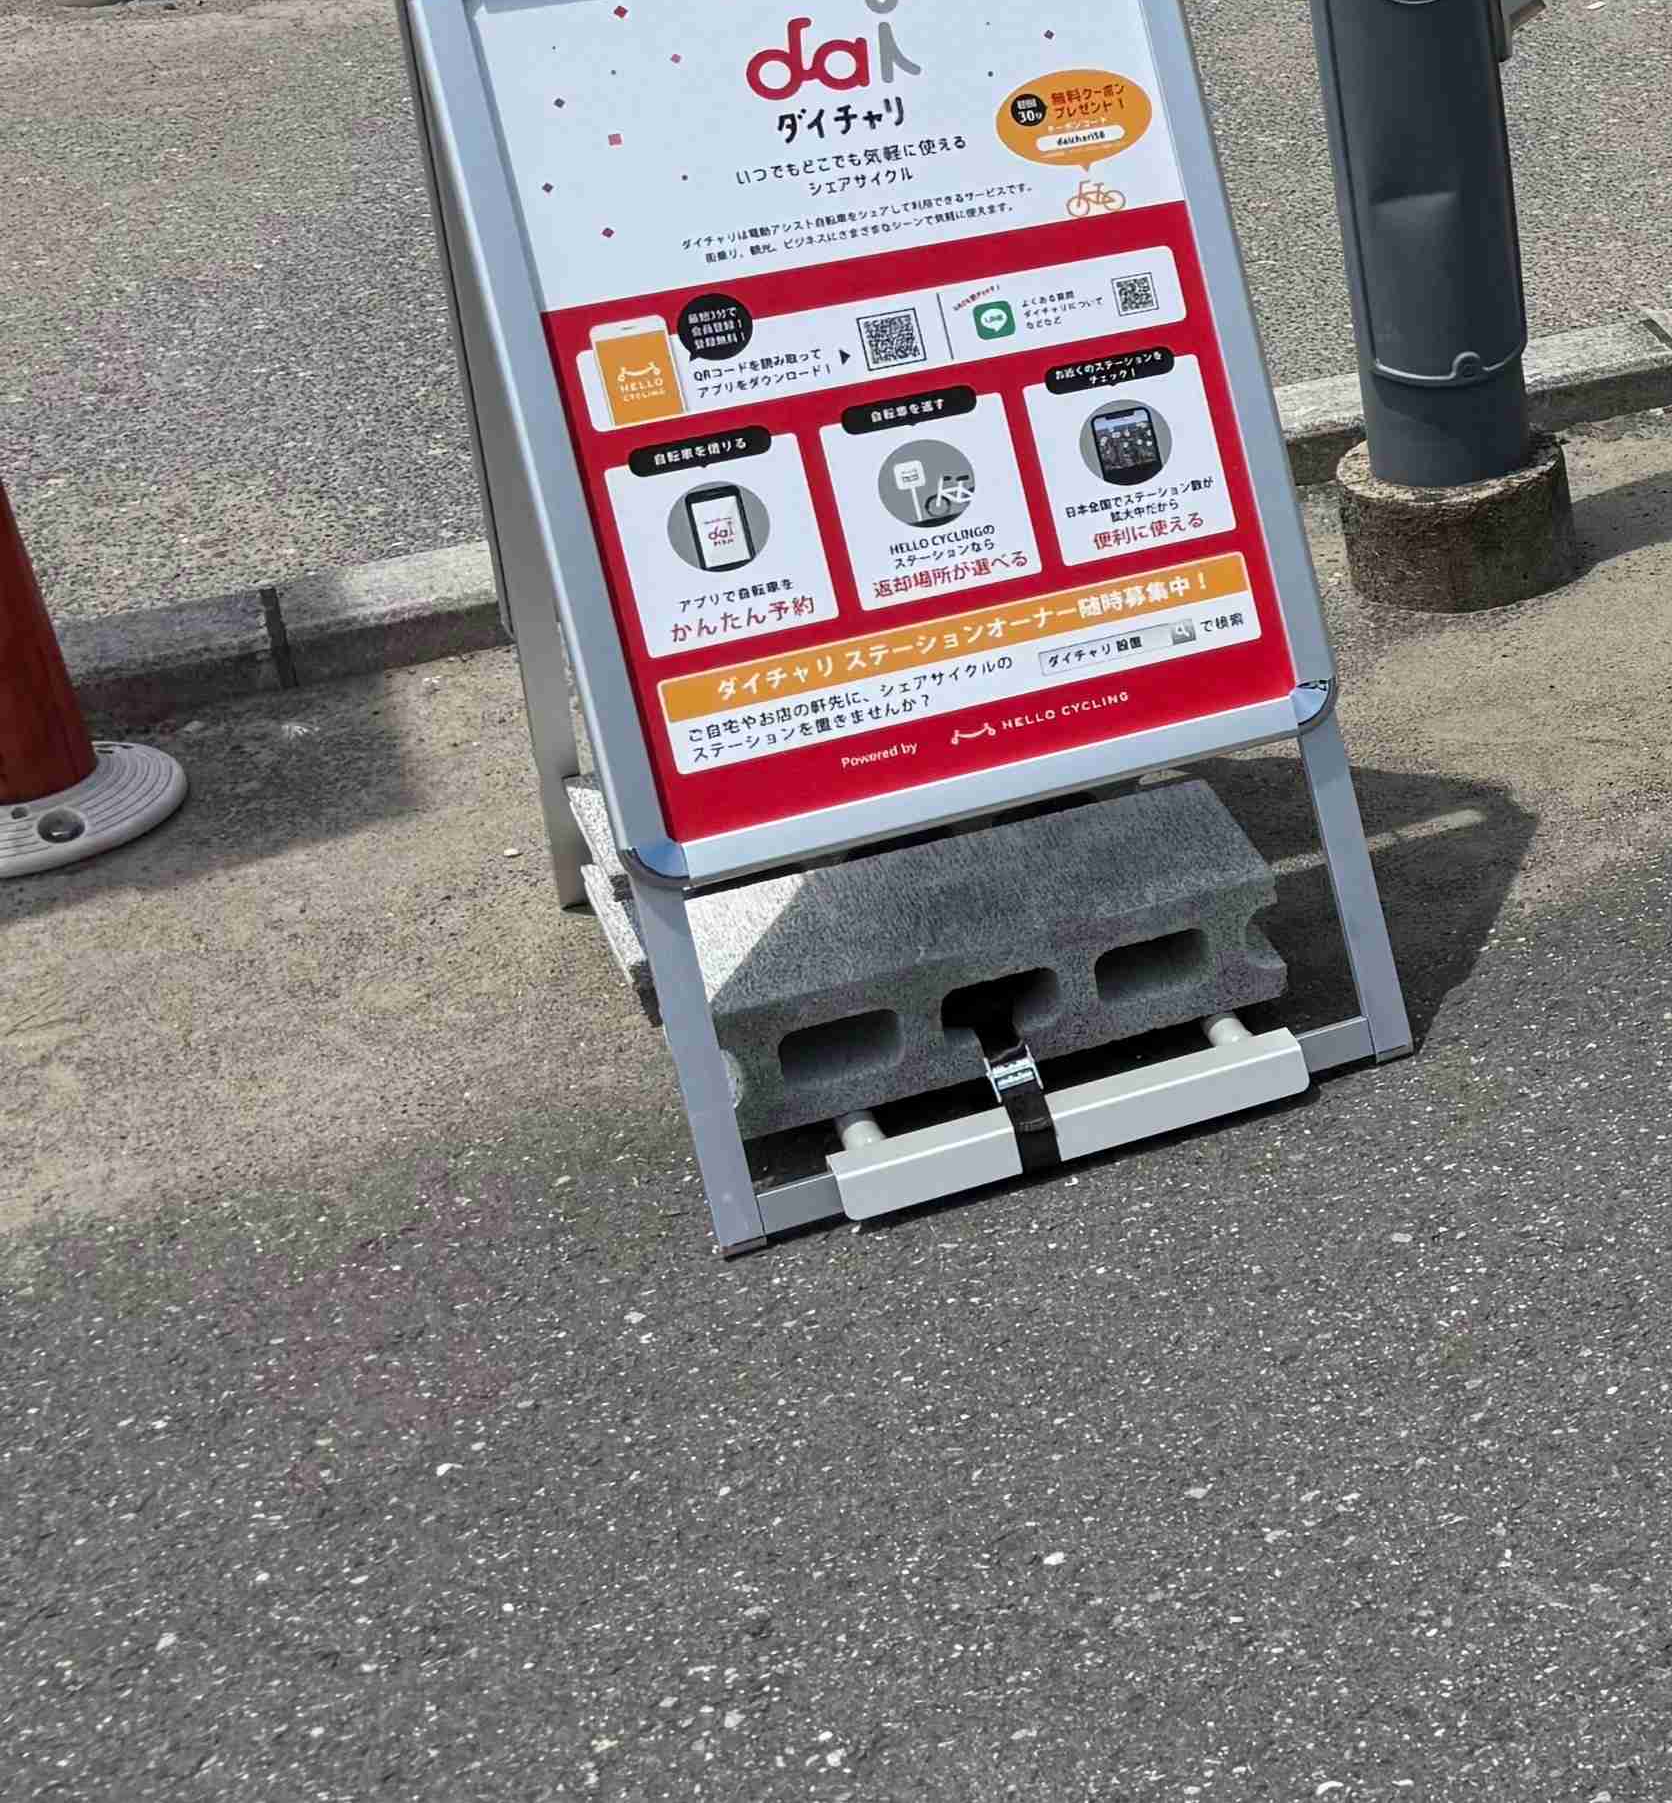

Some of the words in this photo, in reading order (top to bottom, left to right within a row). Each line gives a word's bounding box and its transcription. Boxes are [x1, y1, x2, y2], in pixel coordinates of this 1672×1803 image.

[1051, 84, 1124, 105] 無料クーポン
[777, 97, 904, 143] ダイチャリ
[737, 136, 966, 185] いつでもどこでも気軽に使える
[809, 167, 912, 196] シェアサイクル
[693, 348, 822, 382] QRコードを読み取って
[697, 365, 831, 398] アプリをダウンロード！
[1055, 351, 1162, 381] お近くのステーションを
[620, 379, 664, 393] HELLO
[870, 397, 945, 424] 自転車を返す
[654, 438, 747, 466] 自転車を借りる
[1065, 476, 1214, 519] 日本全国でステーション数が
[890, 533, 930, 556] HELLO
[1093, 512, 1204, 551] 便利に使える
[894, 538, 995, 569] ステーションなら
[873, 549, 1028, 598] 返却場所が選べる
[680, 578, 794, 613] アプリで自転車を
[671, 595, 815, 643] かんたん予約
[1201, 613, 1244, 635] で検索
[1047, 642, 1114, 669] ダイチャリ
[717, 656, 833, 702] ダイチャリ
[688, 655, 1013, 743] ご自宅やお店の軒先に、シェアサイクルの
[1002, 709, 1056, 730] HELLO
[1061, 692, 1129, 716] CYCLING
[692, 693, 931, 763] ステーションを置きませんか？
[841, 744, 896, 768] Powered
[899, 740, 918, 759] by
